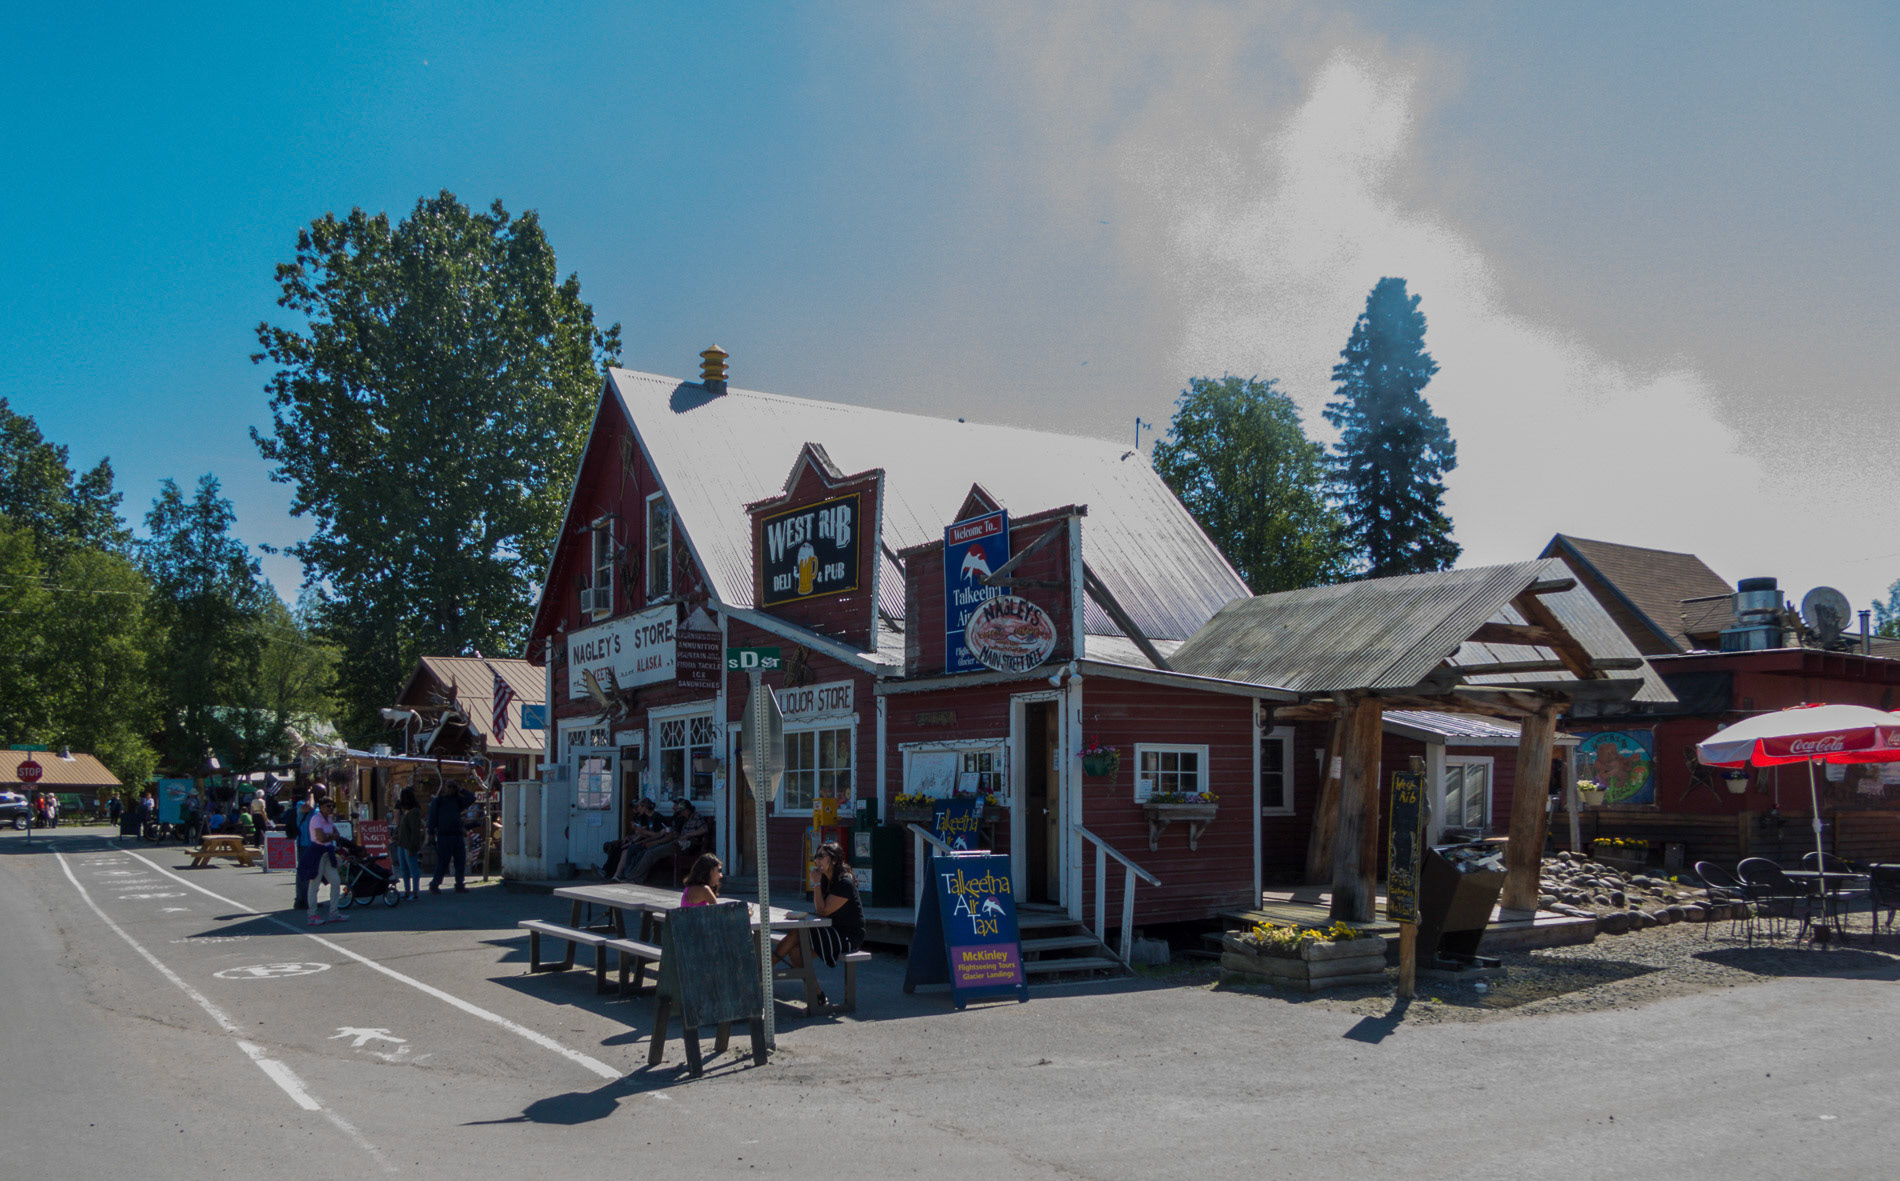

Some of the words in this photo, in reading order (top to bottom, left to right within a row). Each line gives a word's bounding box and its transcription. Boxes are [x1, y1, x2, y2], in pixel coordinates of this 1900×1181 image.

[767, 512, 815, 564] WEST
[819, 504, 852, 549] RIB
[954, 525, 983, 541] Welcome
[773, 573, 792, 592] DELI
[817, 571, 823, 583] &
[824, 562, 845, 582] PUB
[983, 598, 1042, 626] NAGLEY'S
[573, 633, 621, 666] NAGLEY'S
[634, 619, 673, 649] STORE
[678, 641, 720, 651] AMMUNITION
[637, 654, 662, 673] ALASKA
[740, 651, 759, 668] D
[979, 646, 1002, 669] MAIN
[692, 671, 706, 679] ICE
[678, 680, 721, 689] SANDWICHES
[780, 690, 814, 715] LIQUOR
[818, 686, 851, 711] STORE
[19, 767, 41, 777] STOP
[1399, 791, 1416, 804] Rib
[361, 824, 388, 833] Kettle
[936, 808, 979, 835] Talkeetna
[941, 868, 1010, 898] Talkeetna
[954, 894, 979, 916] Air
[967, 914, 999, 937] Taxi
[962, 951, 1007, 962] McKinley
[958, 963, 997, 972] Flightseeing
[986, 971, 1015, 979] Landings
